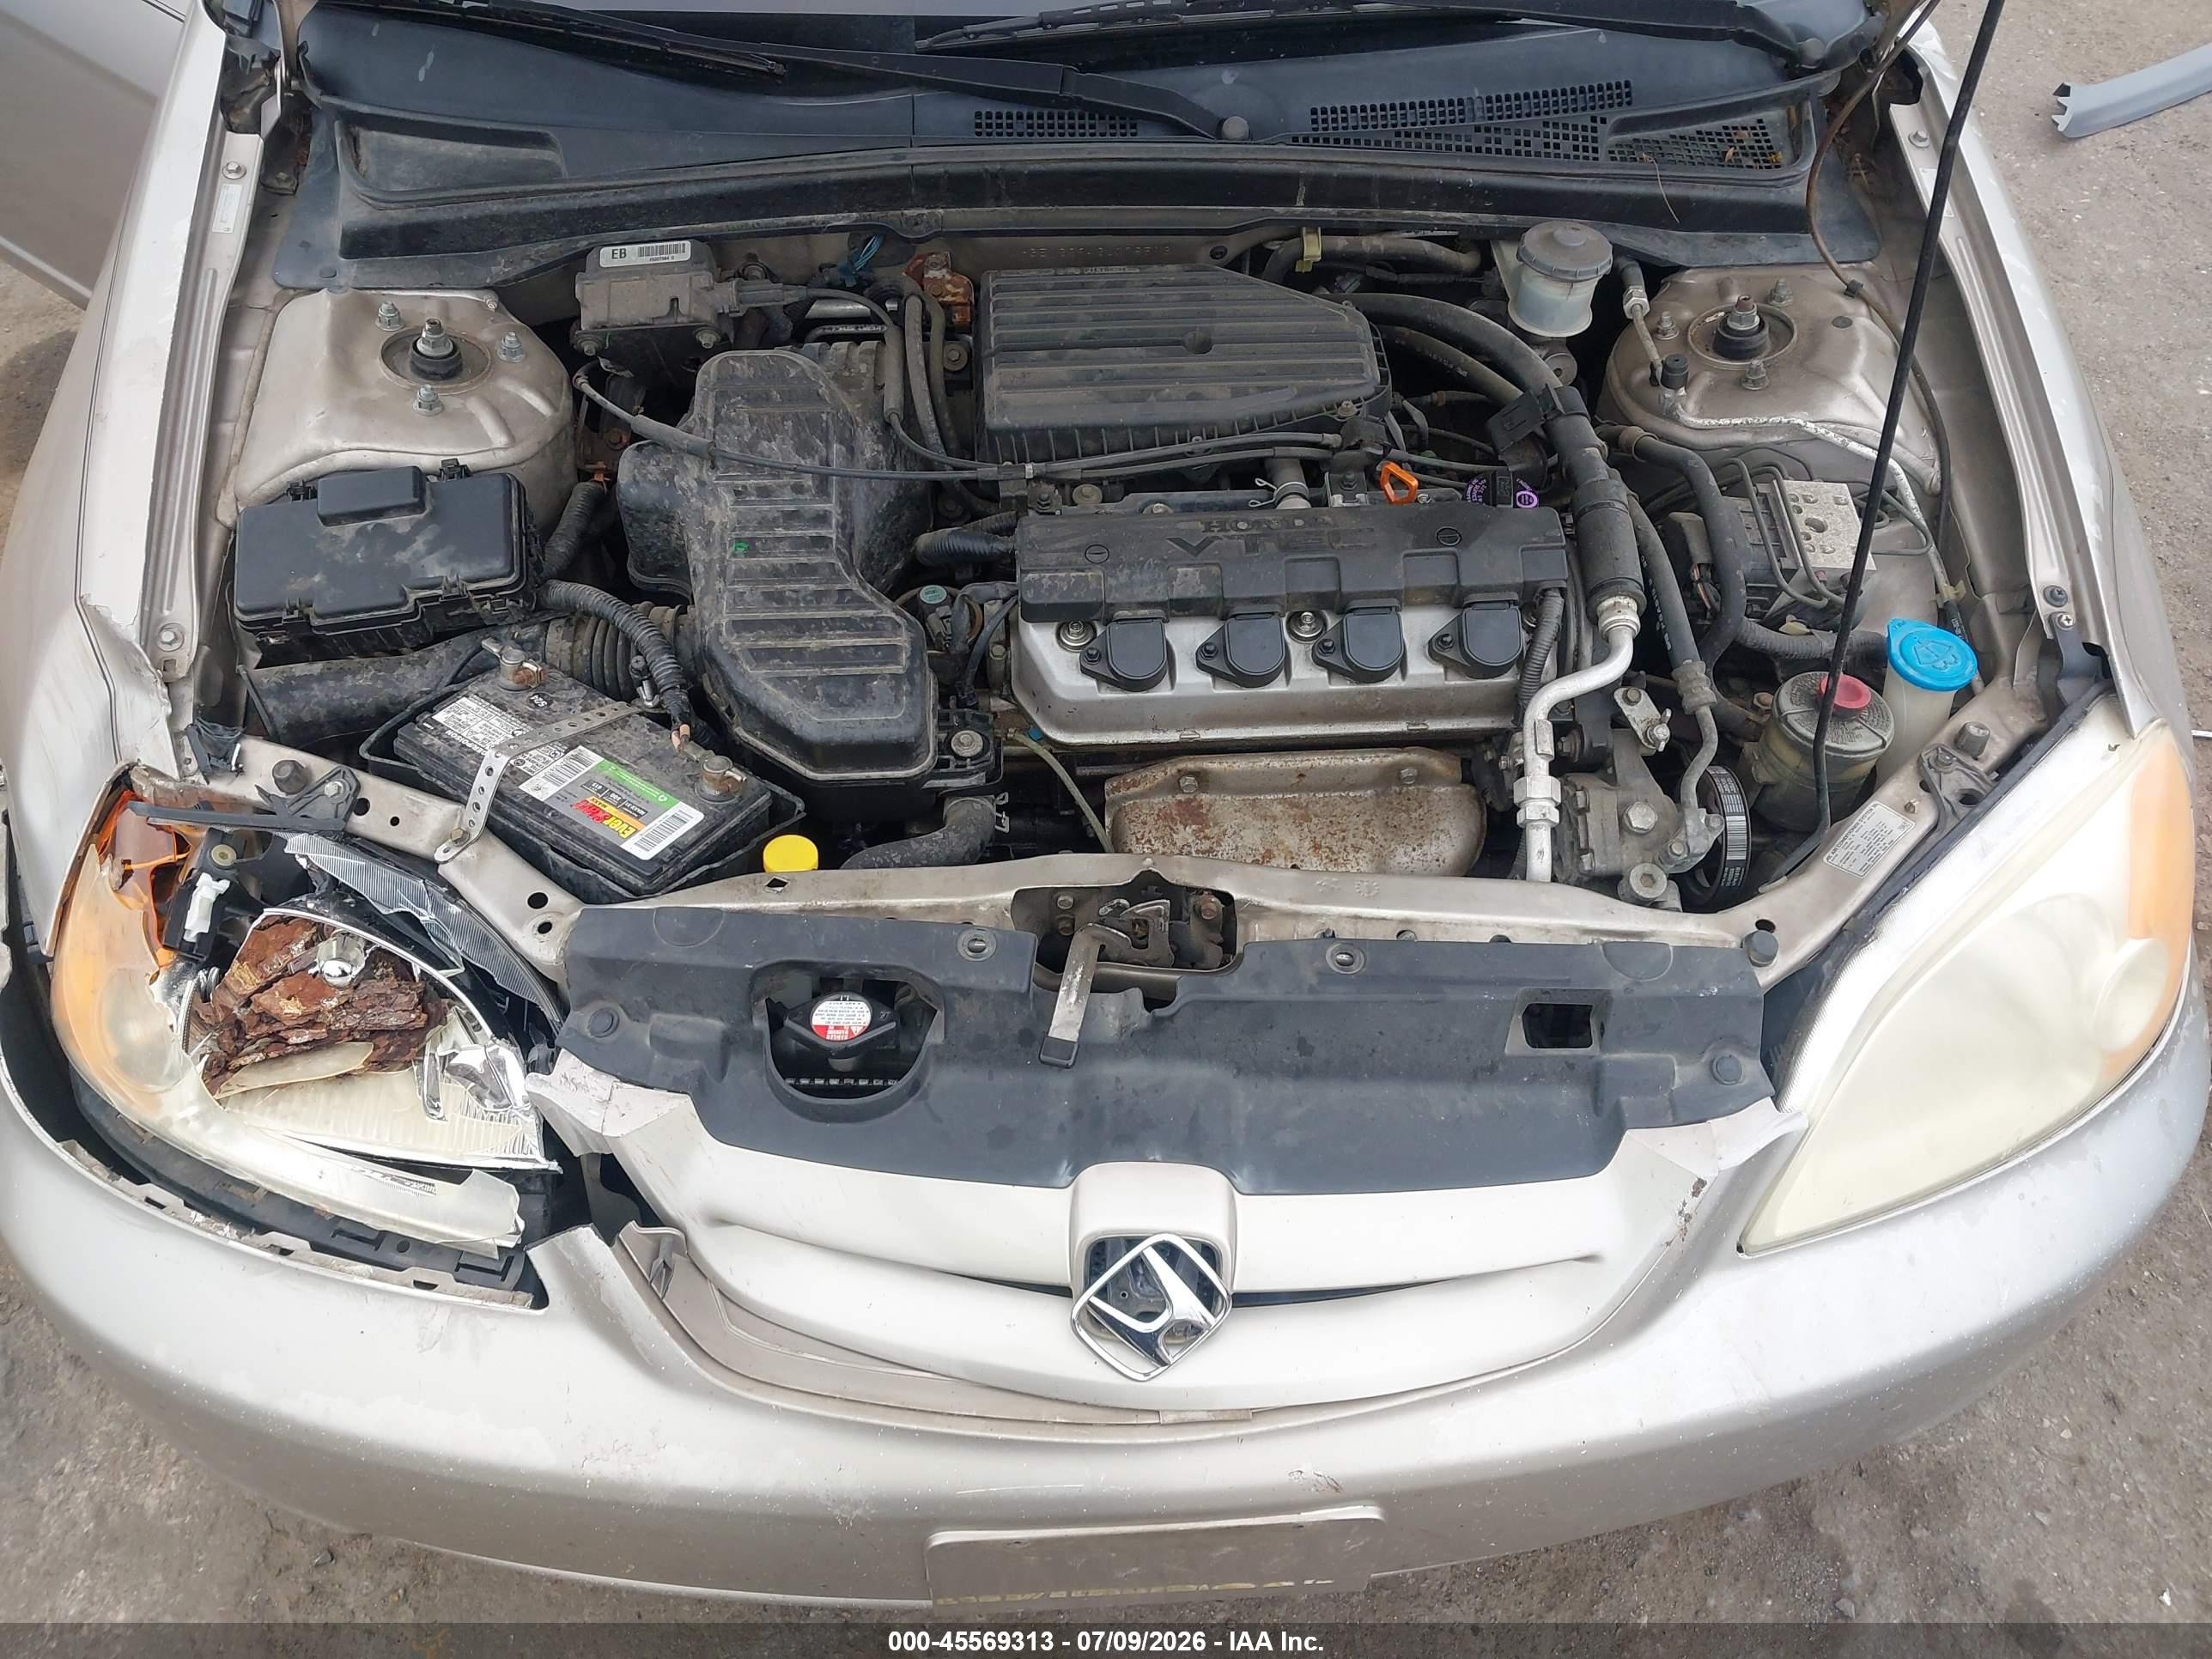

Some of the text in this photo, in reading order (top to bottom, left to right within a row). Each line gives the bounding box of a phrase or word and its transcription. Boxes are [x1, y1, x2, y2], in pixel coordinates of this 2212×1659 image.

[612, 249, 627, 259] EB
[1202, 515, 1339, 533] HONDA
[1165, 527, 1376, 556] VTEC
[571, 799, 637, 839] EverStart
